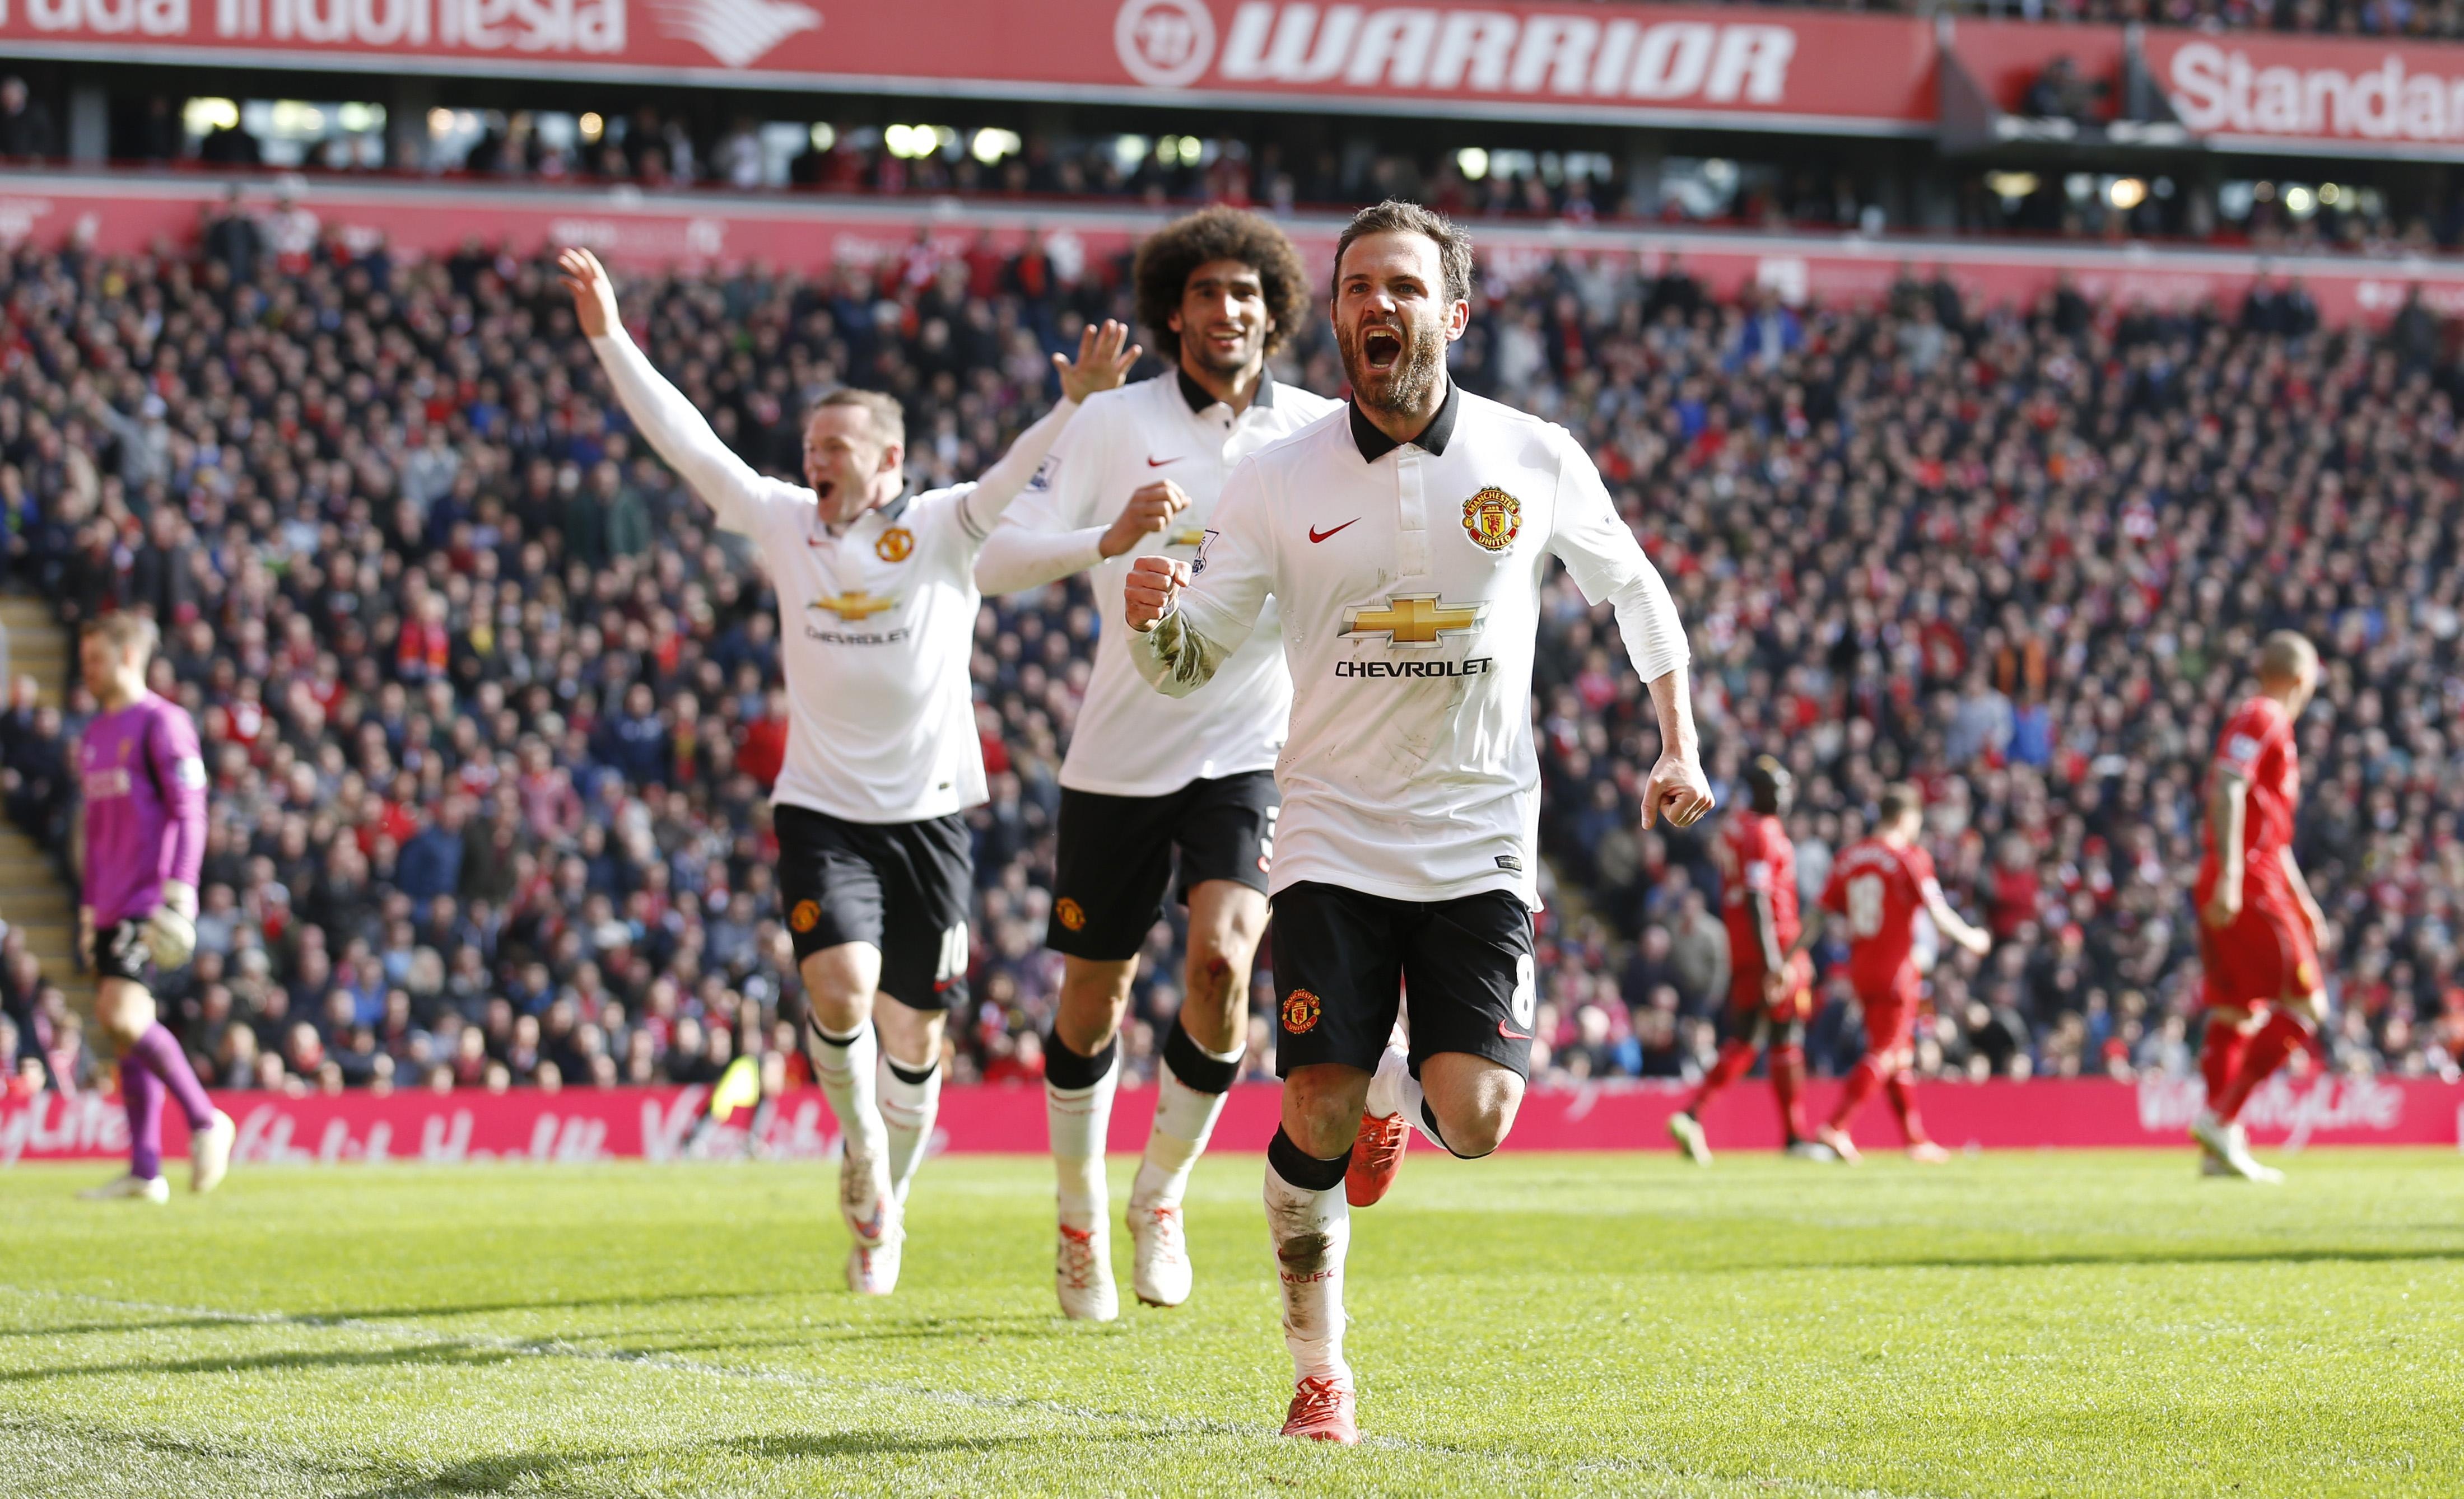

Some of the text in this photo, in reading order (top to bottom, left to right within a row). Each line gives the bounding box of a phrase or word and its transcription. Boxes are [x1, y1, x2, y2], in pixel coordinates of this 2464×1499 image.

[1220, 1, 1796, 103] WARRIOR
[1468, 492, 1516, 513] MANCHESTER
[1478, 535, 1511, 546] UNITED
[805, 625, 910, 645] CHEVROLET
[1335, 658, 1492, 678] CHEVROLET
[934, 920, 969, 981] 10
[1285, 992, 1316, 1008] MANCHESTER
[1511, 953, 1536, 1030] 8
[1289, 1021, 1311, 1030] UNITED
[1280, 1267, 1338, 1283] MUFC
